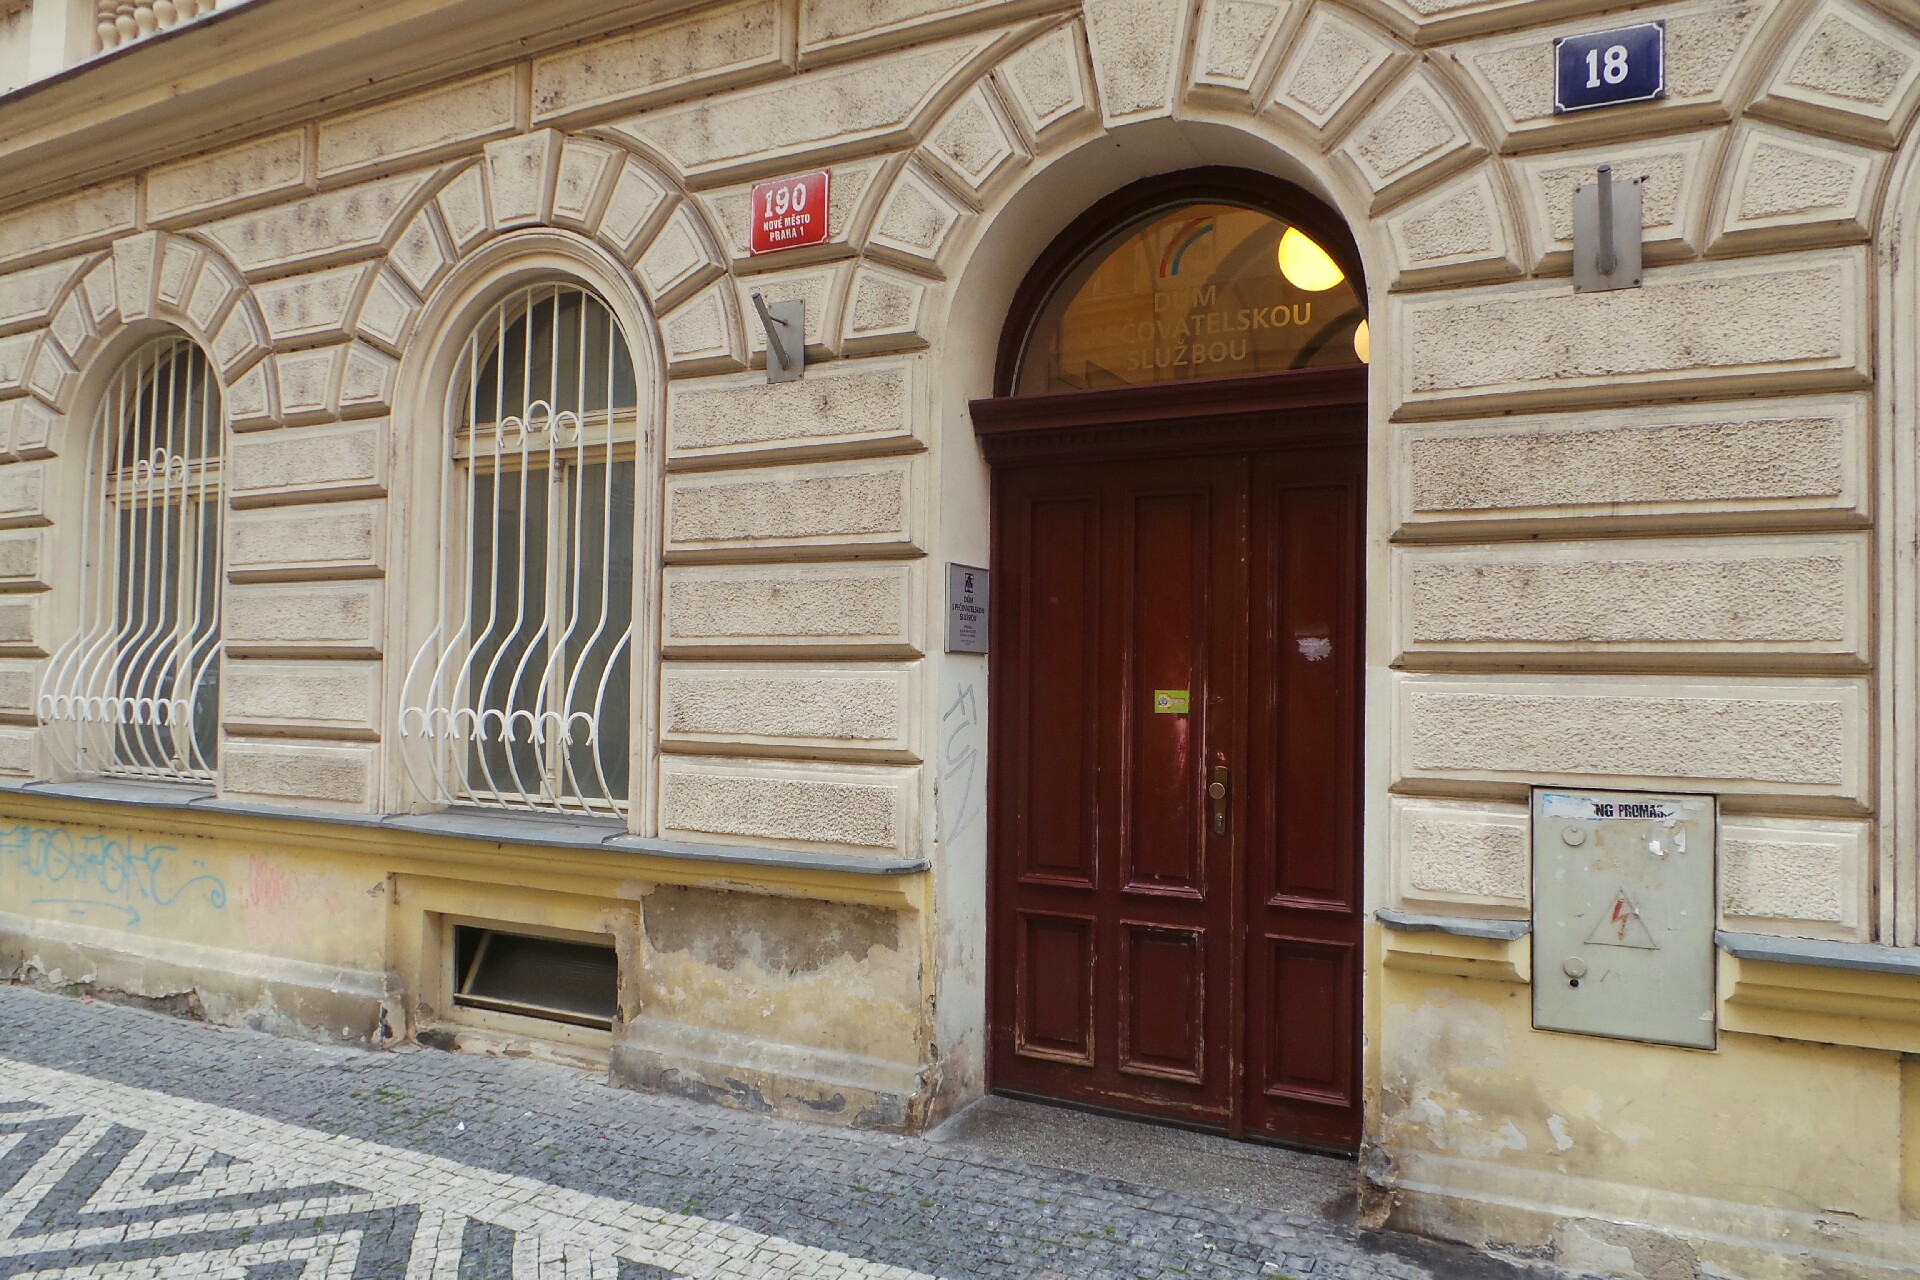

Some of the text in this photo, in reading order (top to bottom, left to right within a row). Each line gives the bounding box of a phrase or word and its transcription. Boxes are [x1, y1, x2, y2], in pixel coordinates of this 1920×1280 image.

[1586, 45, 1628, 88] 18
[764, 183, 807, 218] 190
[763, 213, 811, 231] NOVÉ MĚSTO
[769, 226, 804, 242] PRAHA 1
[1091, 302, 1312, 346] ČOVATELSKOU
[1128, 339, 1247, 371] SLUŽBOU
[1592, 803, 1614, 817] NG
